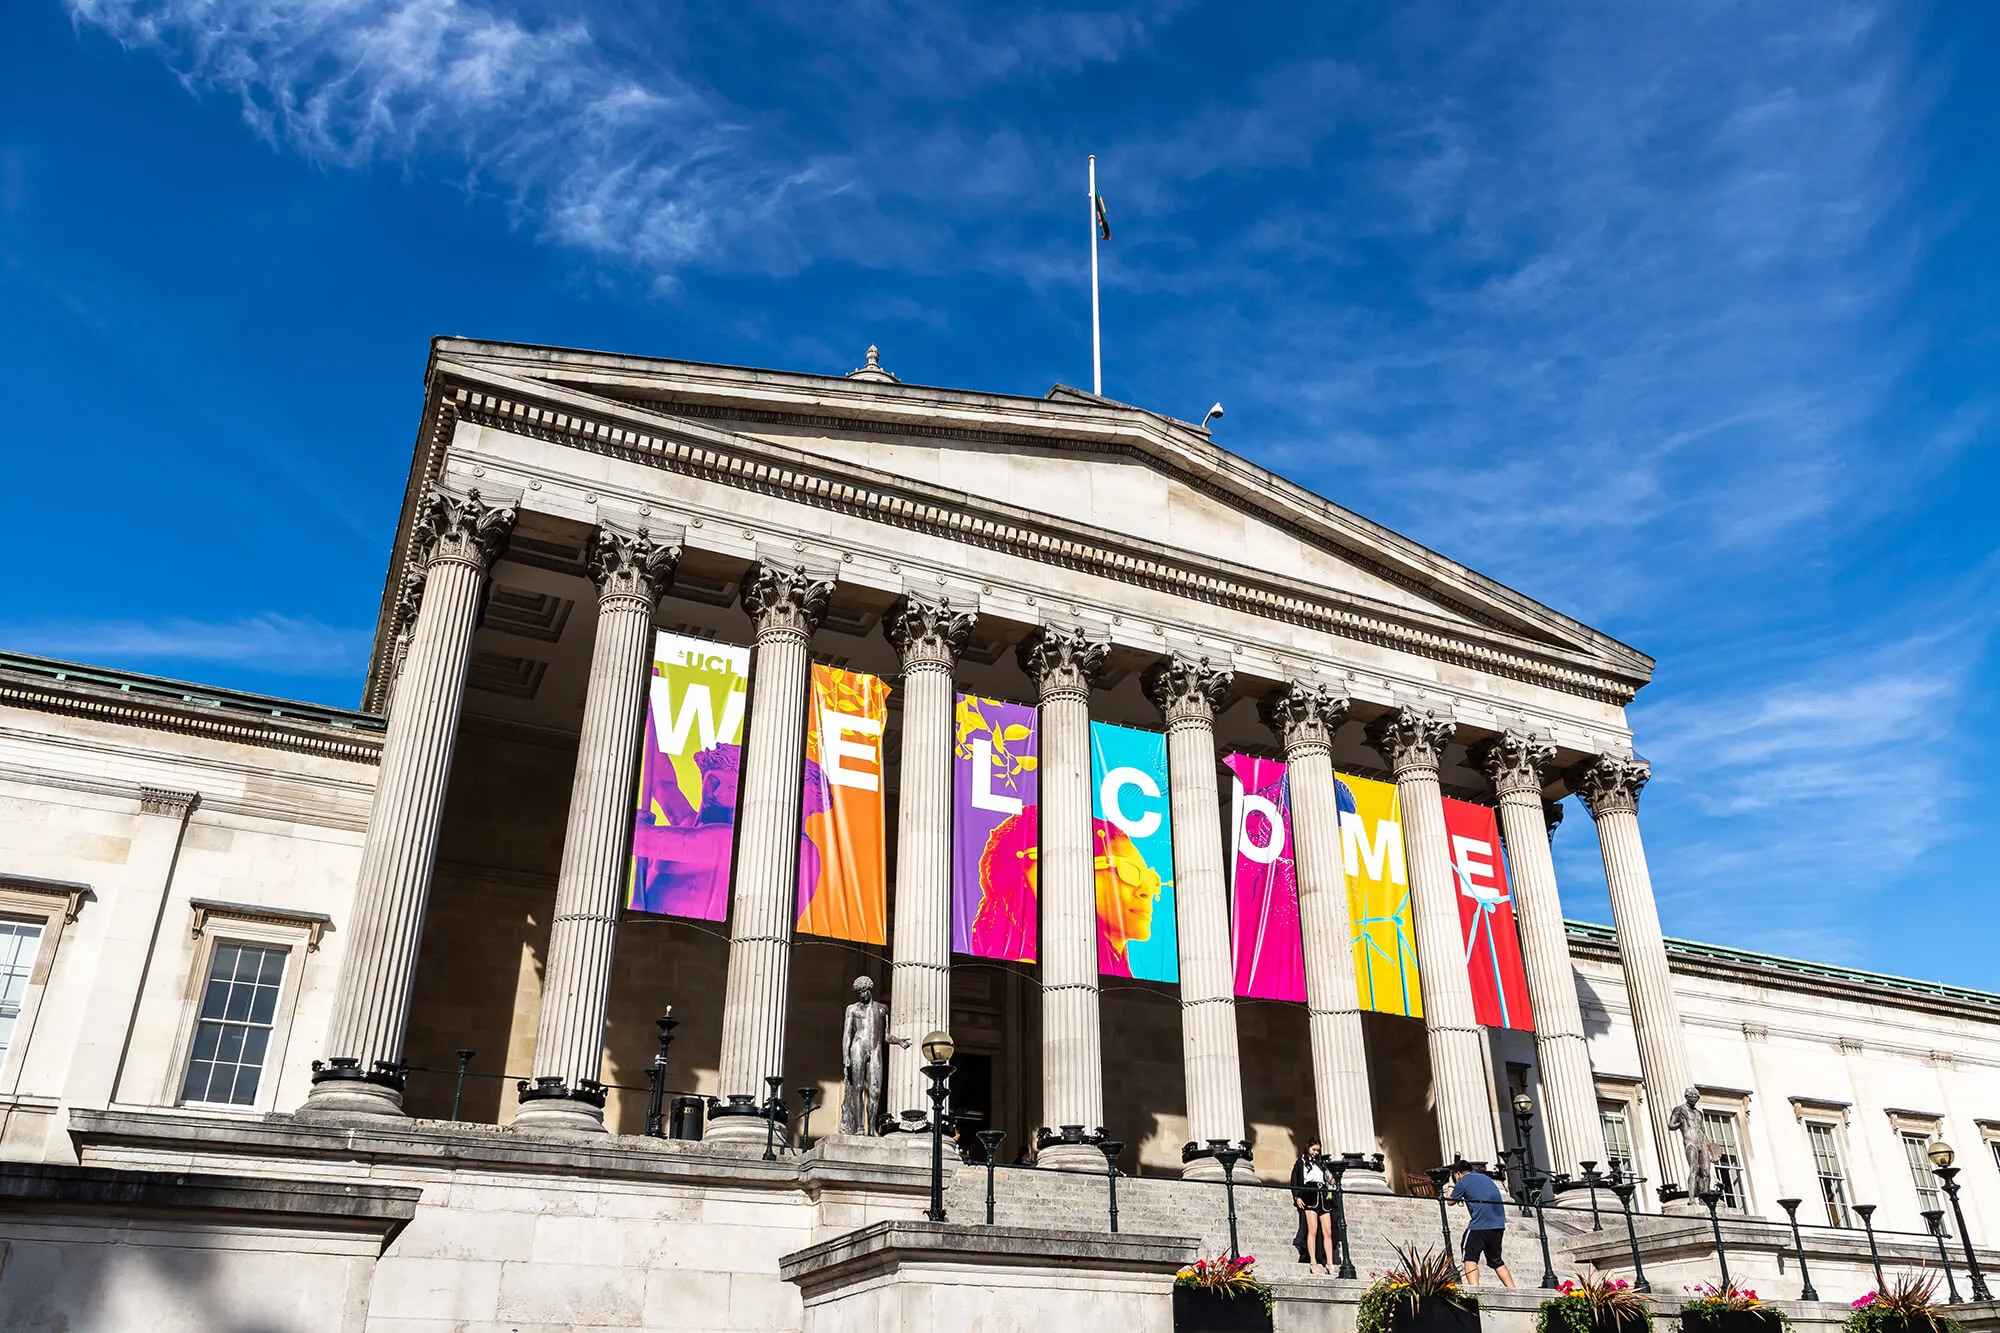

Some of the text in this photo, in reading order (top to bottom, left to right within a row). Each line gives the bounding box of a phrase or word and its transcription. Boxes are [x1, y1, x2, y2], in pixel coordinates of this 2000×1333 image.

[686, 650, 738, 675] UCL
[649, 675, 746, 757] W
[822, 709, 880, 793] E
[971, 738, 1023, 815] L
[1100, 766, 1162, 838] C
[1238, 794, 1285, 863] O
[1340, 811, 1405, 886] M
[1452, 834, 1500, 900] E
